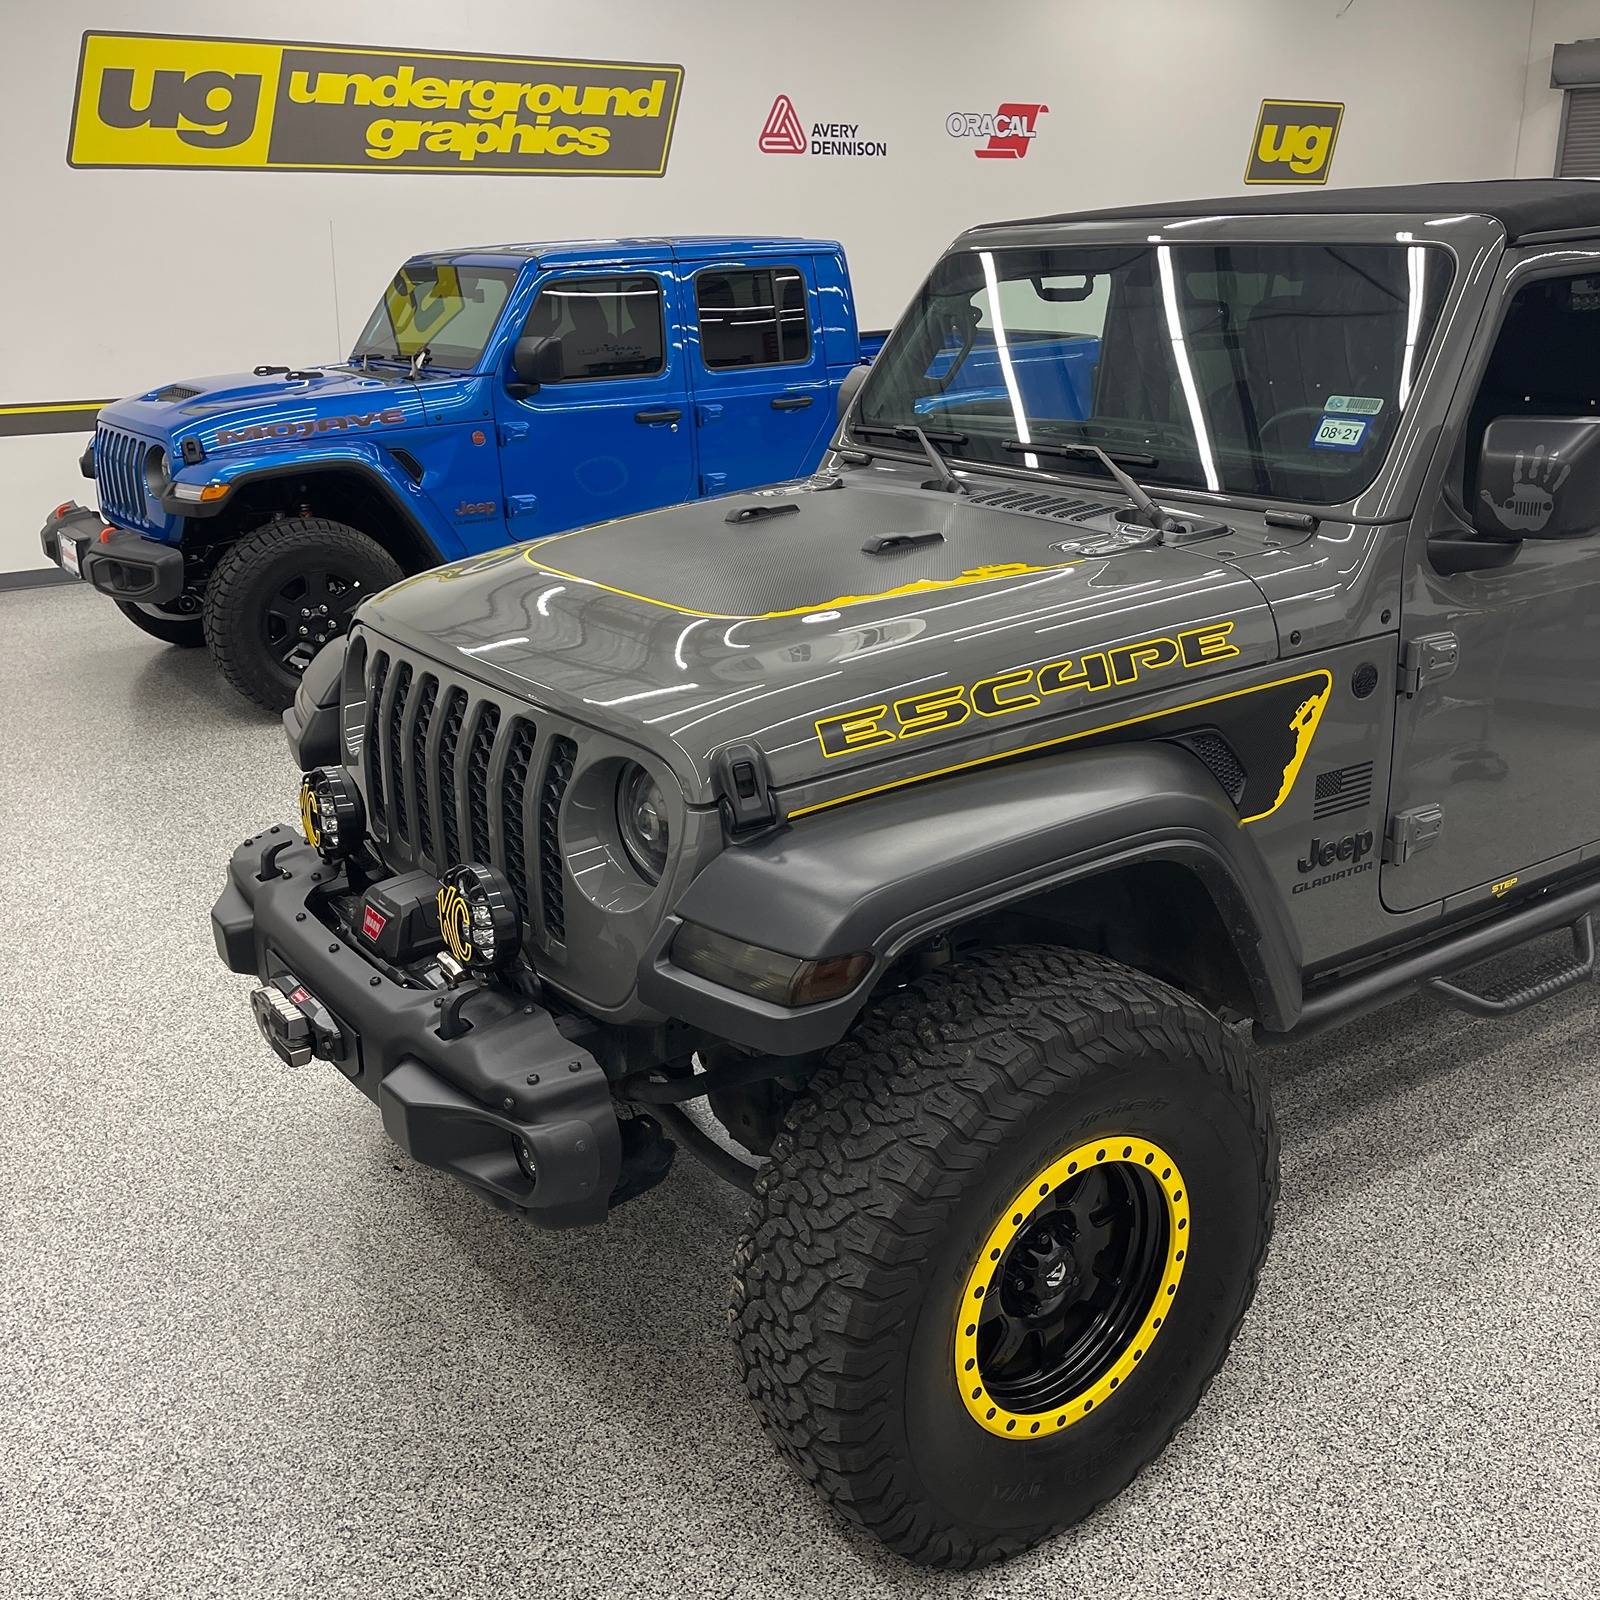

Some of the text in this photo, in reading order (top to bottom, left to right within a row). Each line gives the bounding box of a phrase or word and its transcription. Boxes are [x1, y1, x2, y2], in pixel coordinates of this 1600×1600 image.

[97, 68, 262, 148] ug
[288, 66, 663, 118] underground
[365, 115, 610, 160] graphics
[811, 123, 859, 138] AVERY
[946, 111, 1036, 138] ORACAL
[811, 140, 887, 156] DENNISON
[1257, 124, 1332, 174] ug
[216, 409, 407, 446] MOJAVE
[455, 500, 496, 516] Jeep
[1297, 829, 1374, 873] Jeep
[1291, 861, 1374, 894] GLADIATOR
[1491, 877, 1518, 894] STEP
